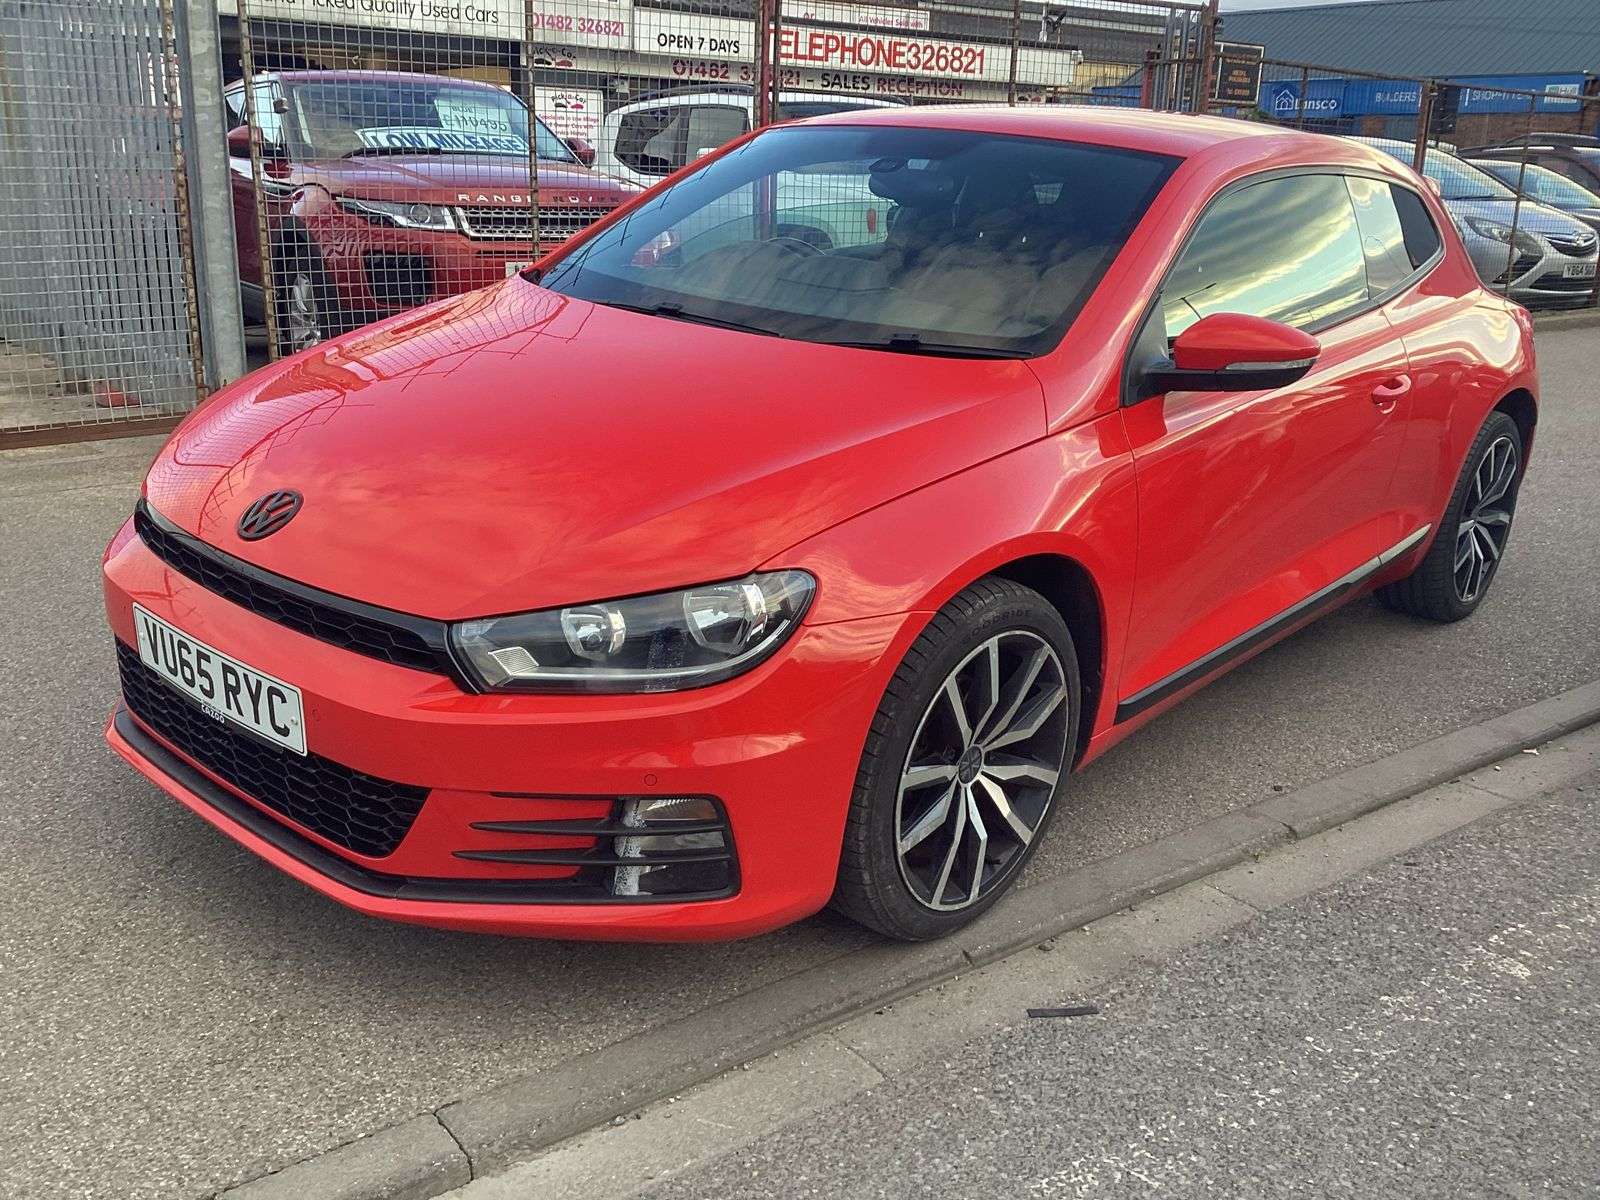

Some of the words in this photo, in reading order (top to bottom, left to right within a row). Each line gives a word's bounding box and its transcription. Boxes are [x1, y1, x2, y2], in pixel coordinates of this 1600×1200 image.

[361, 0, 415, 20] Quality
[421, 0, 460, 20] Used
[465, 5, 499, 24] Cars
[533, 12, 573, 32] 01482
[578, 17, 625, 37] 326821
[657, 33, 694, 50] OPEN
[697, 37, 706, 51] 7
[709, 38, 740, 54] DAYS
[768, 28, 985, 75] ELEPHONE326821
[820, 73, 870, 91] SALES
[876, 77, 963, 97] RECEPTION
[367, 131, 427, 149] LOW
[426, 132, 524, 150] MILEAGE
[143, 616, 215, 701] VU65
[221, 660, 291, 738] RYC
